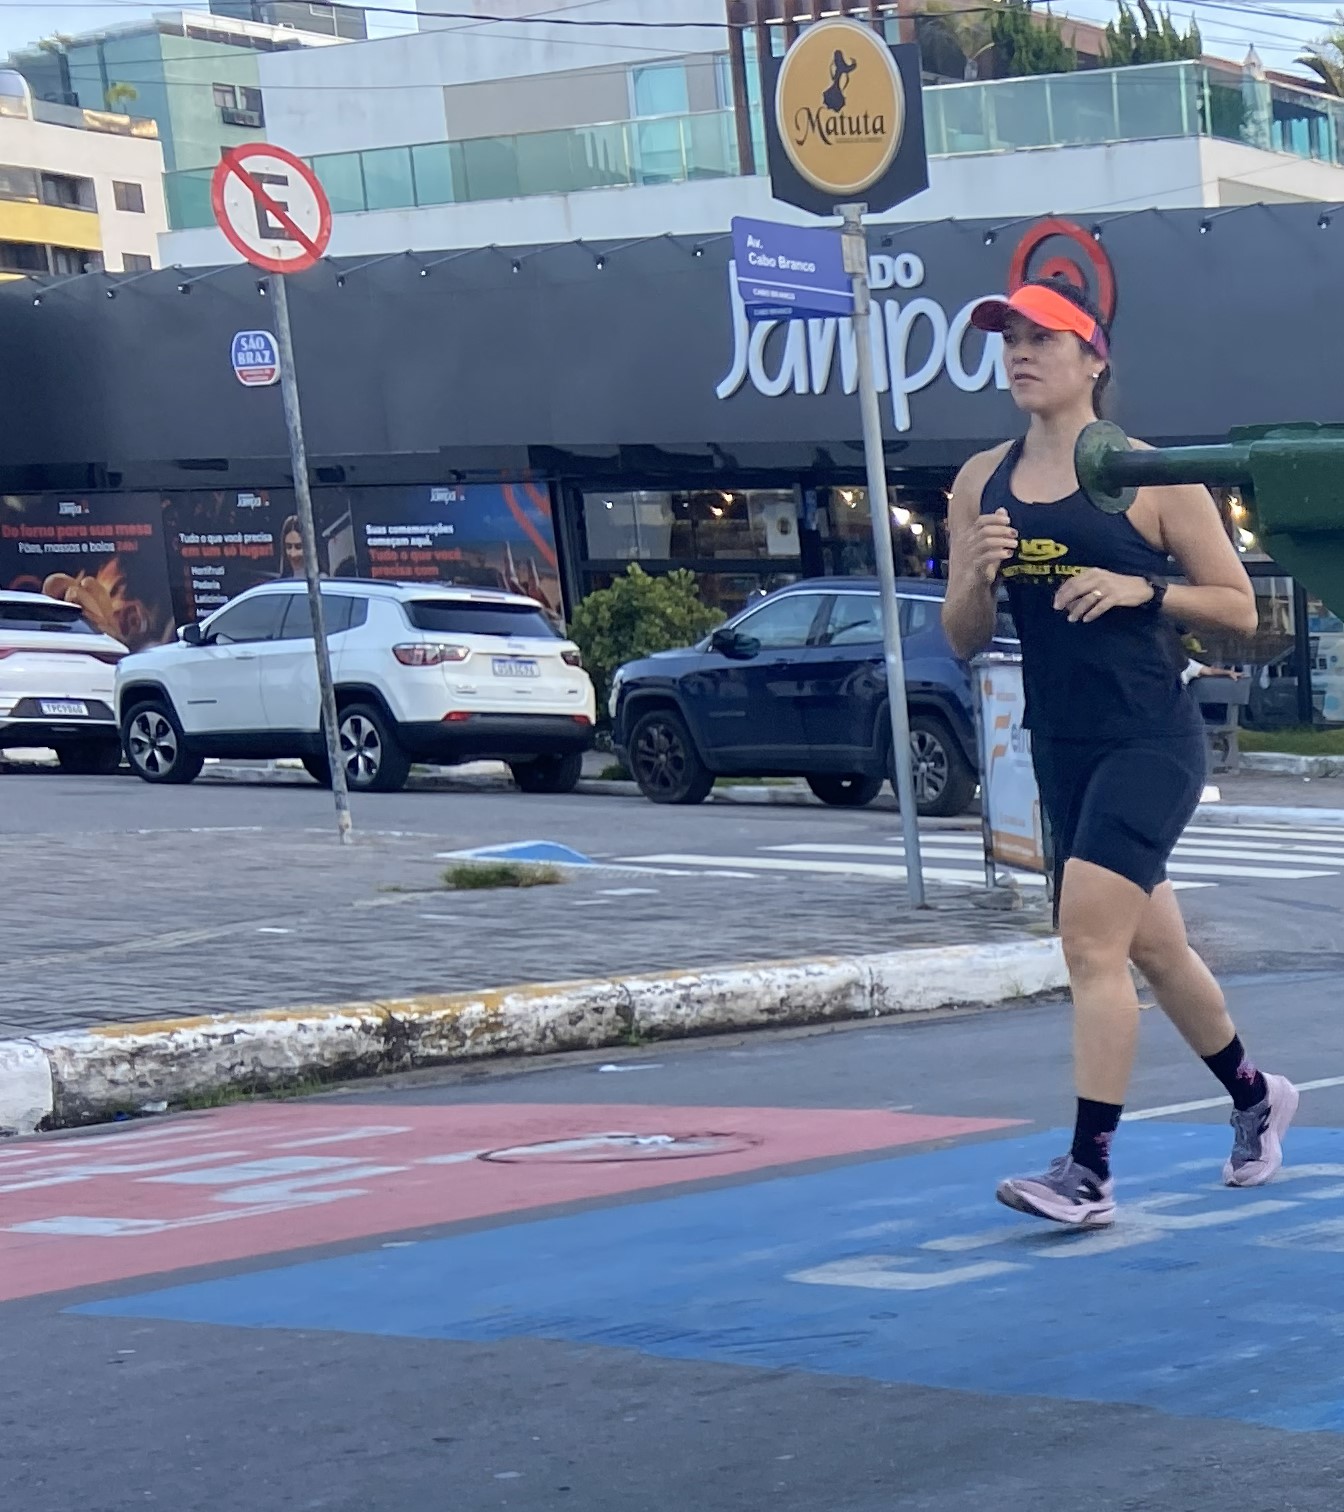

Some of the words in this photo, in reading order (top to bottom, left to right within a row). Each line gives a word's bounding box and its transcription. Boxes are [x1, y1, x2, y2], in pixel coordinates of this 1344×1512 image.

[795, 107, 886, 146] Matuta
[250, 171, 294, 240] E
[746, 234, 763, 249] Av.
[748, 252, 777, 268] Cabo
[778, 255, 816, 273] Branco
[240, 334, 265, 351] SÃO
[715, 259, 1010, 432] Jampa
[237, 350, 272, 365] BRAZ
